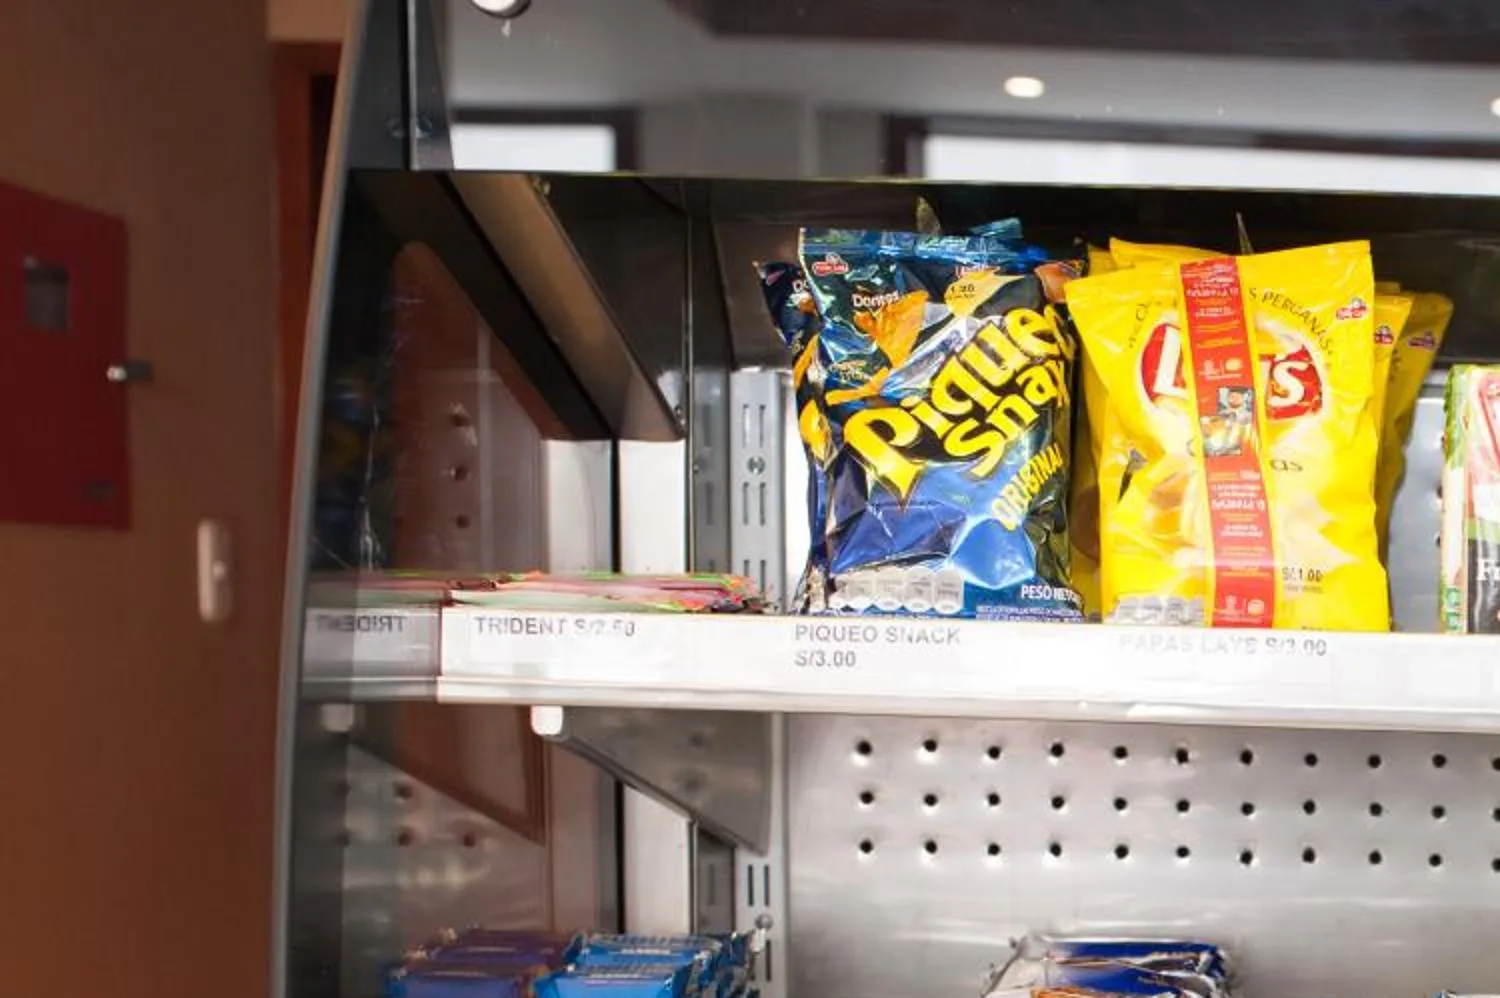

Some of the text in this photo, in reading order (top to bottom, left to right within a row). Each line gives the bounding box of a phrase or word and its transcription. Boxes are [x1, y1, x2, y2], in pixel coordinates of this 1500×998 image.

[1021, 584, 1053, 601] PESO
[474, 616, 569, 636] TRIDENT
[795, 624, 961, 645] PIQUEO SNACK
[1118, 634, 1193, 654] PAPAS
[1201, 636, 1258, 656] LAYS
[795, 649, 857, 669] S/3.00
